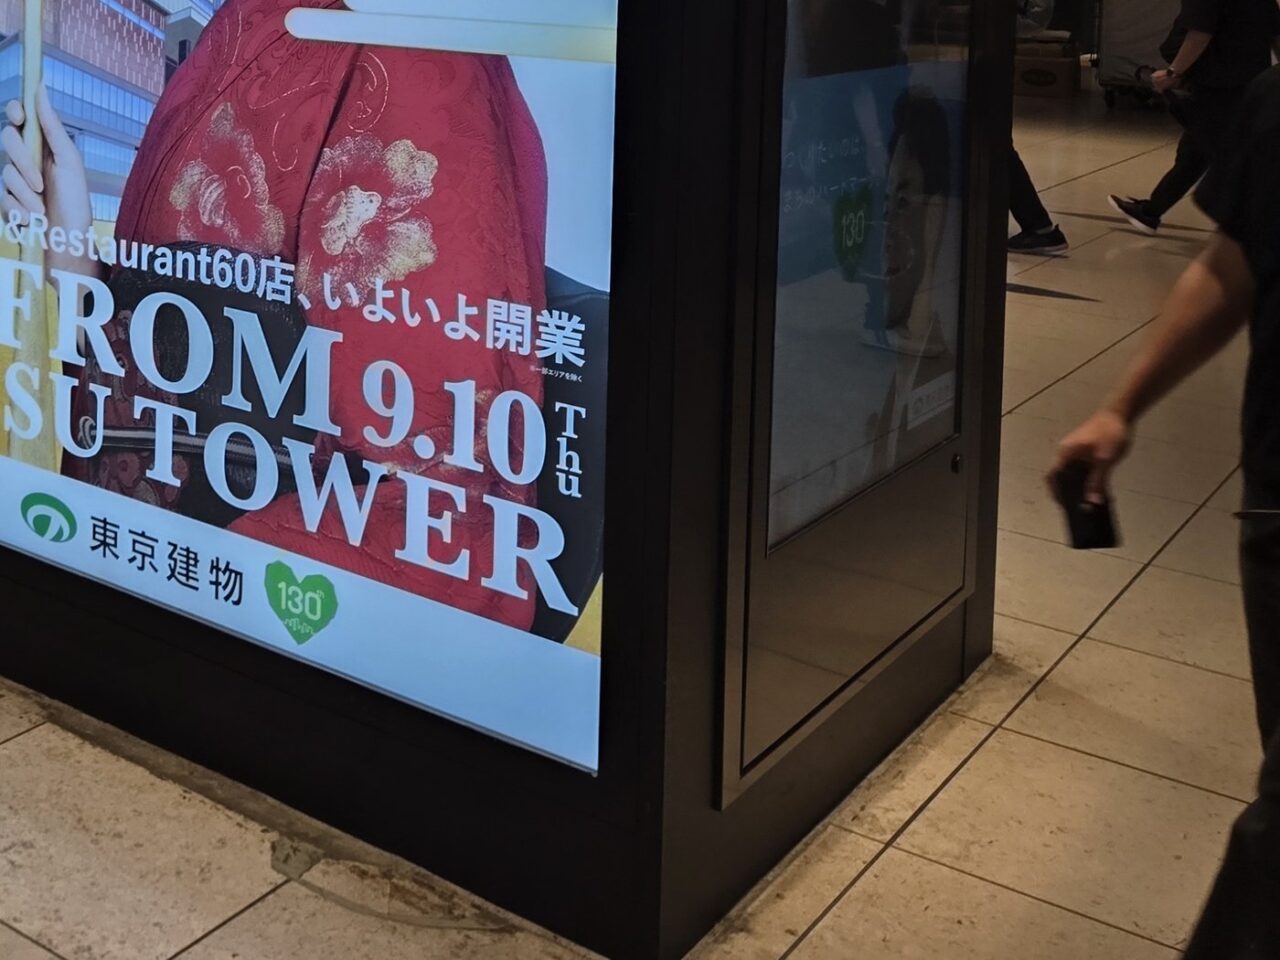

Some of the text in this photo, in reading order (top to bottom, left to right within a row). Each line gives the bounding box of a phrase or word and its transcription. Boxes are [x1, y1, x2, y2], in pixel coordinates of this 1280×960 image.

[841, 209, 865, 248] 130
[361, 359, 547, 486] 9.10
[554, 401, 587, 499] Thu
[132, 394, 580, 617] TOWER
[89, 515, 244, 607] 東京建物
